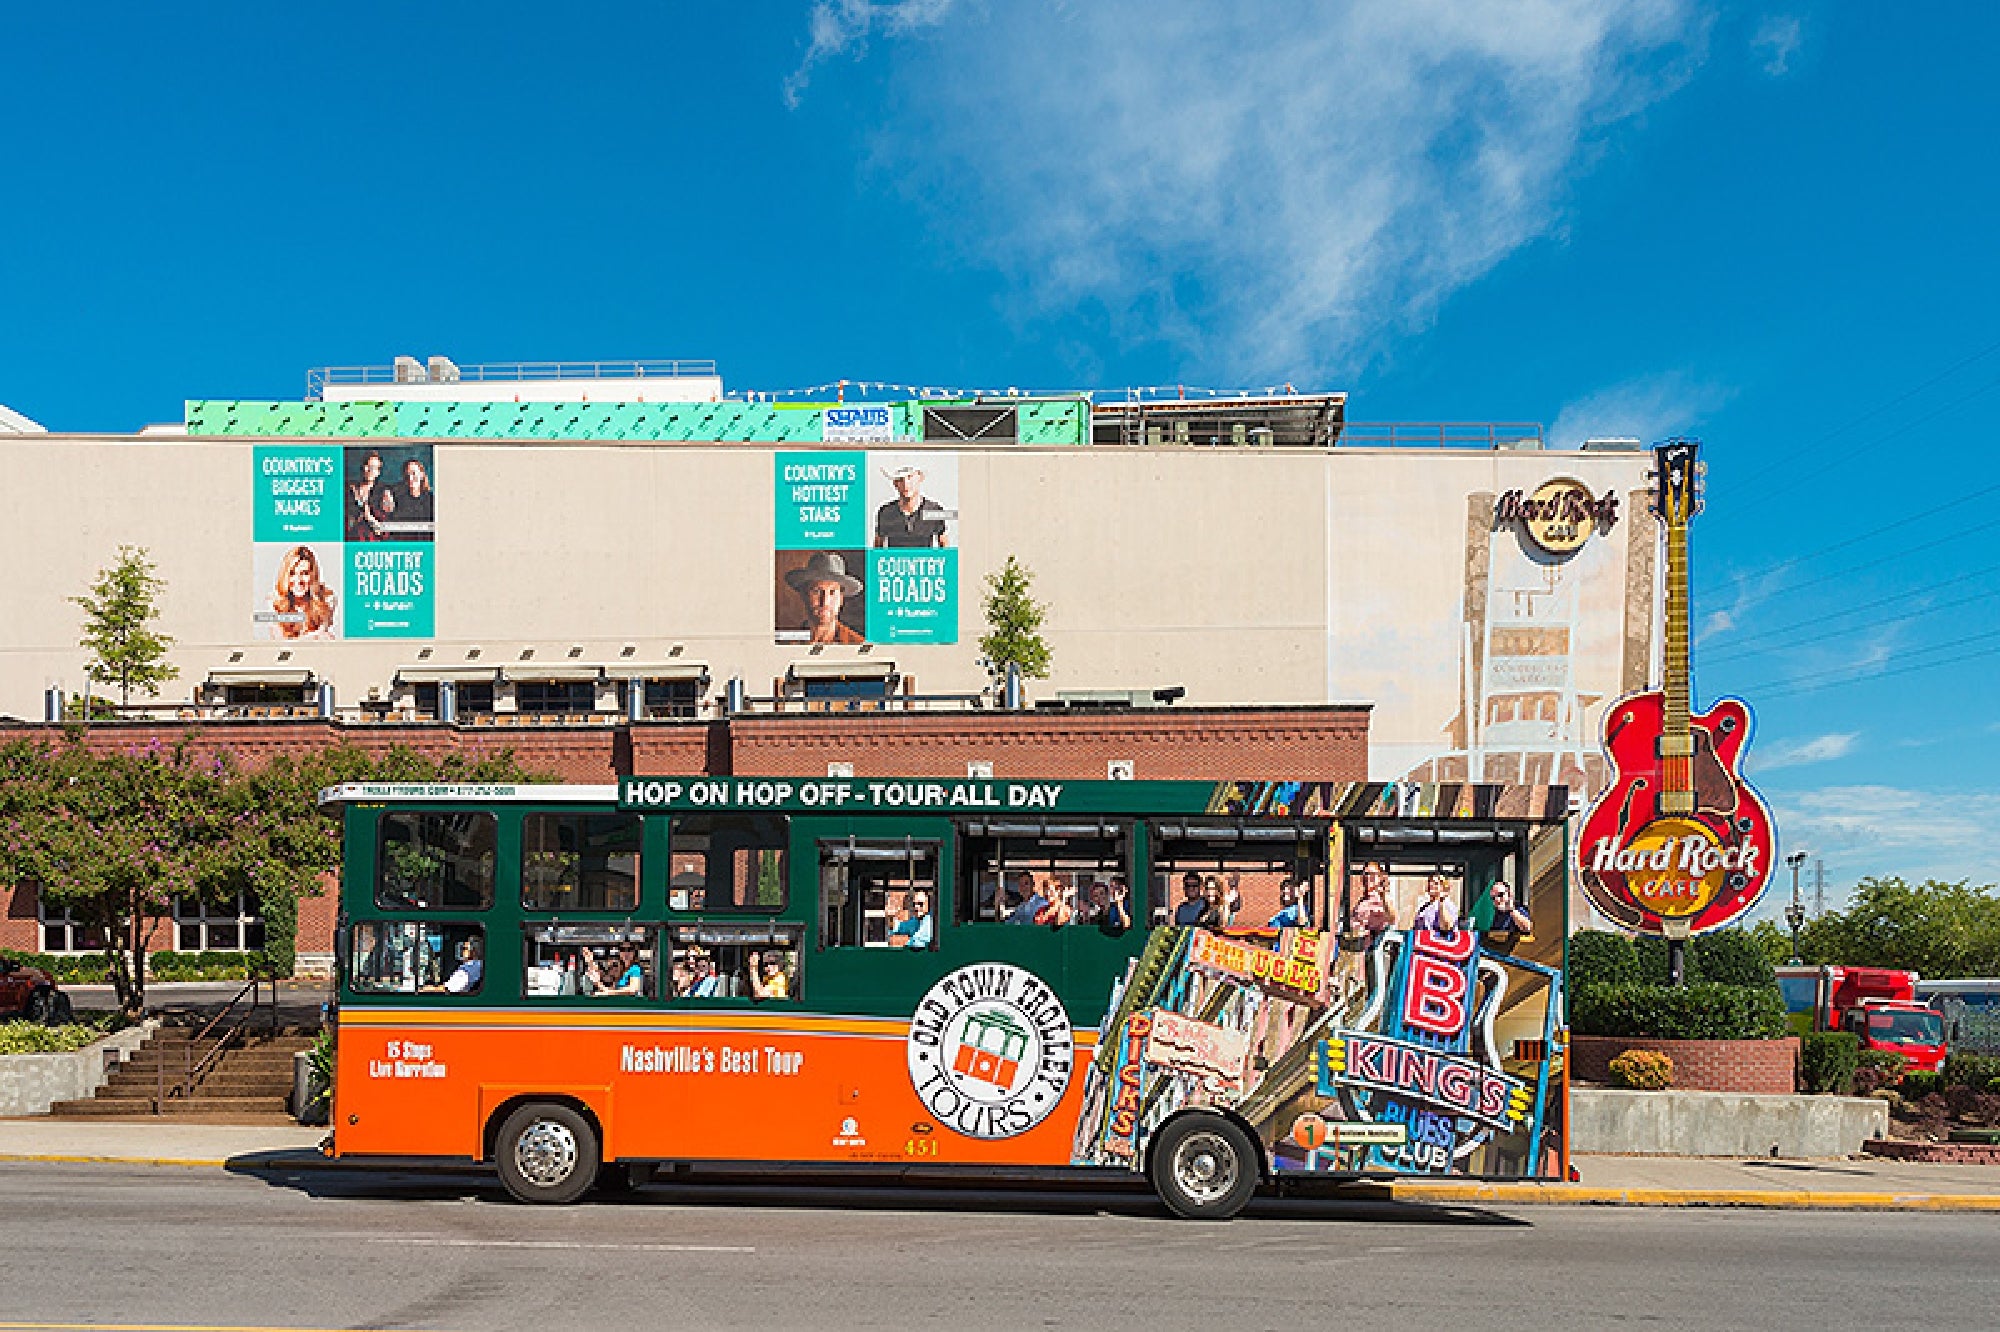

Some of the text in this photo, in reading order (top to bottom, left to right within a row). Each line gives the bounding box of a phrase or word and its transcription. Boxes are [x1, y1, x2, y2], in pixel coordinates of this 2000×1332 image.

[262, 457, 334, 475] COUNTRY'S
[785, 465, 855, 481] COUNTRY'S
[272, 478, 324, 495] BIGGEST
[792, 485, 848, 502] HOTTEST
[274, 500, 321, 515] NAMES
[799, 506, 841, 523] STARS
[354, 552, 423, 570] COUNTRY
[877, 557, 946, 576] COUNTRY
[356, 572, 424, 596] ROADS
[879, 578, 946, 603] ROADS
[625, 782, 680, 806] HOP
[689, 782, 729, 806] ON
[737, 782, 794, 806] HOP
[869, 783, 944, 807] TOUR
[949, 783, 1001, 807] ALL
[1008, 783, 1062, 807] DAY
[1592, 835, 1760, 877] Hard Rock
[1644, 880, 1700, 897] CAFE
[1253, 951, 1321, 991] UGLY
[913, 967, 1071, 1092] OLD TOWN TROLLEY
[621, 1045, 803, 1075] Nashville's Best Tour
[1347, 1040, 1507, 1116] KING'S
[920, 1065, 1032, 1135] TOURS
[1304, 1125, 1314, 1145] 1
[905, 1139, 937, 1156] 451
